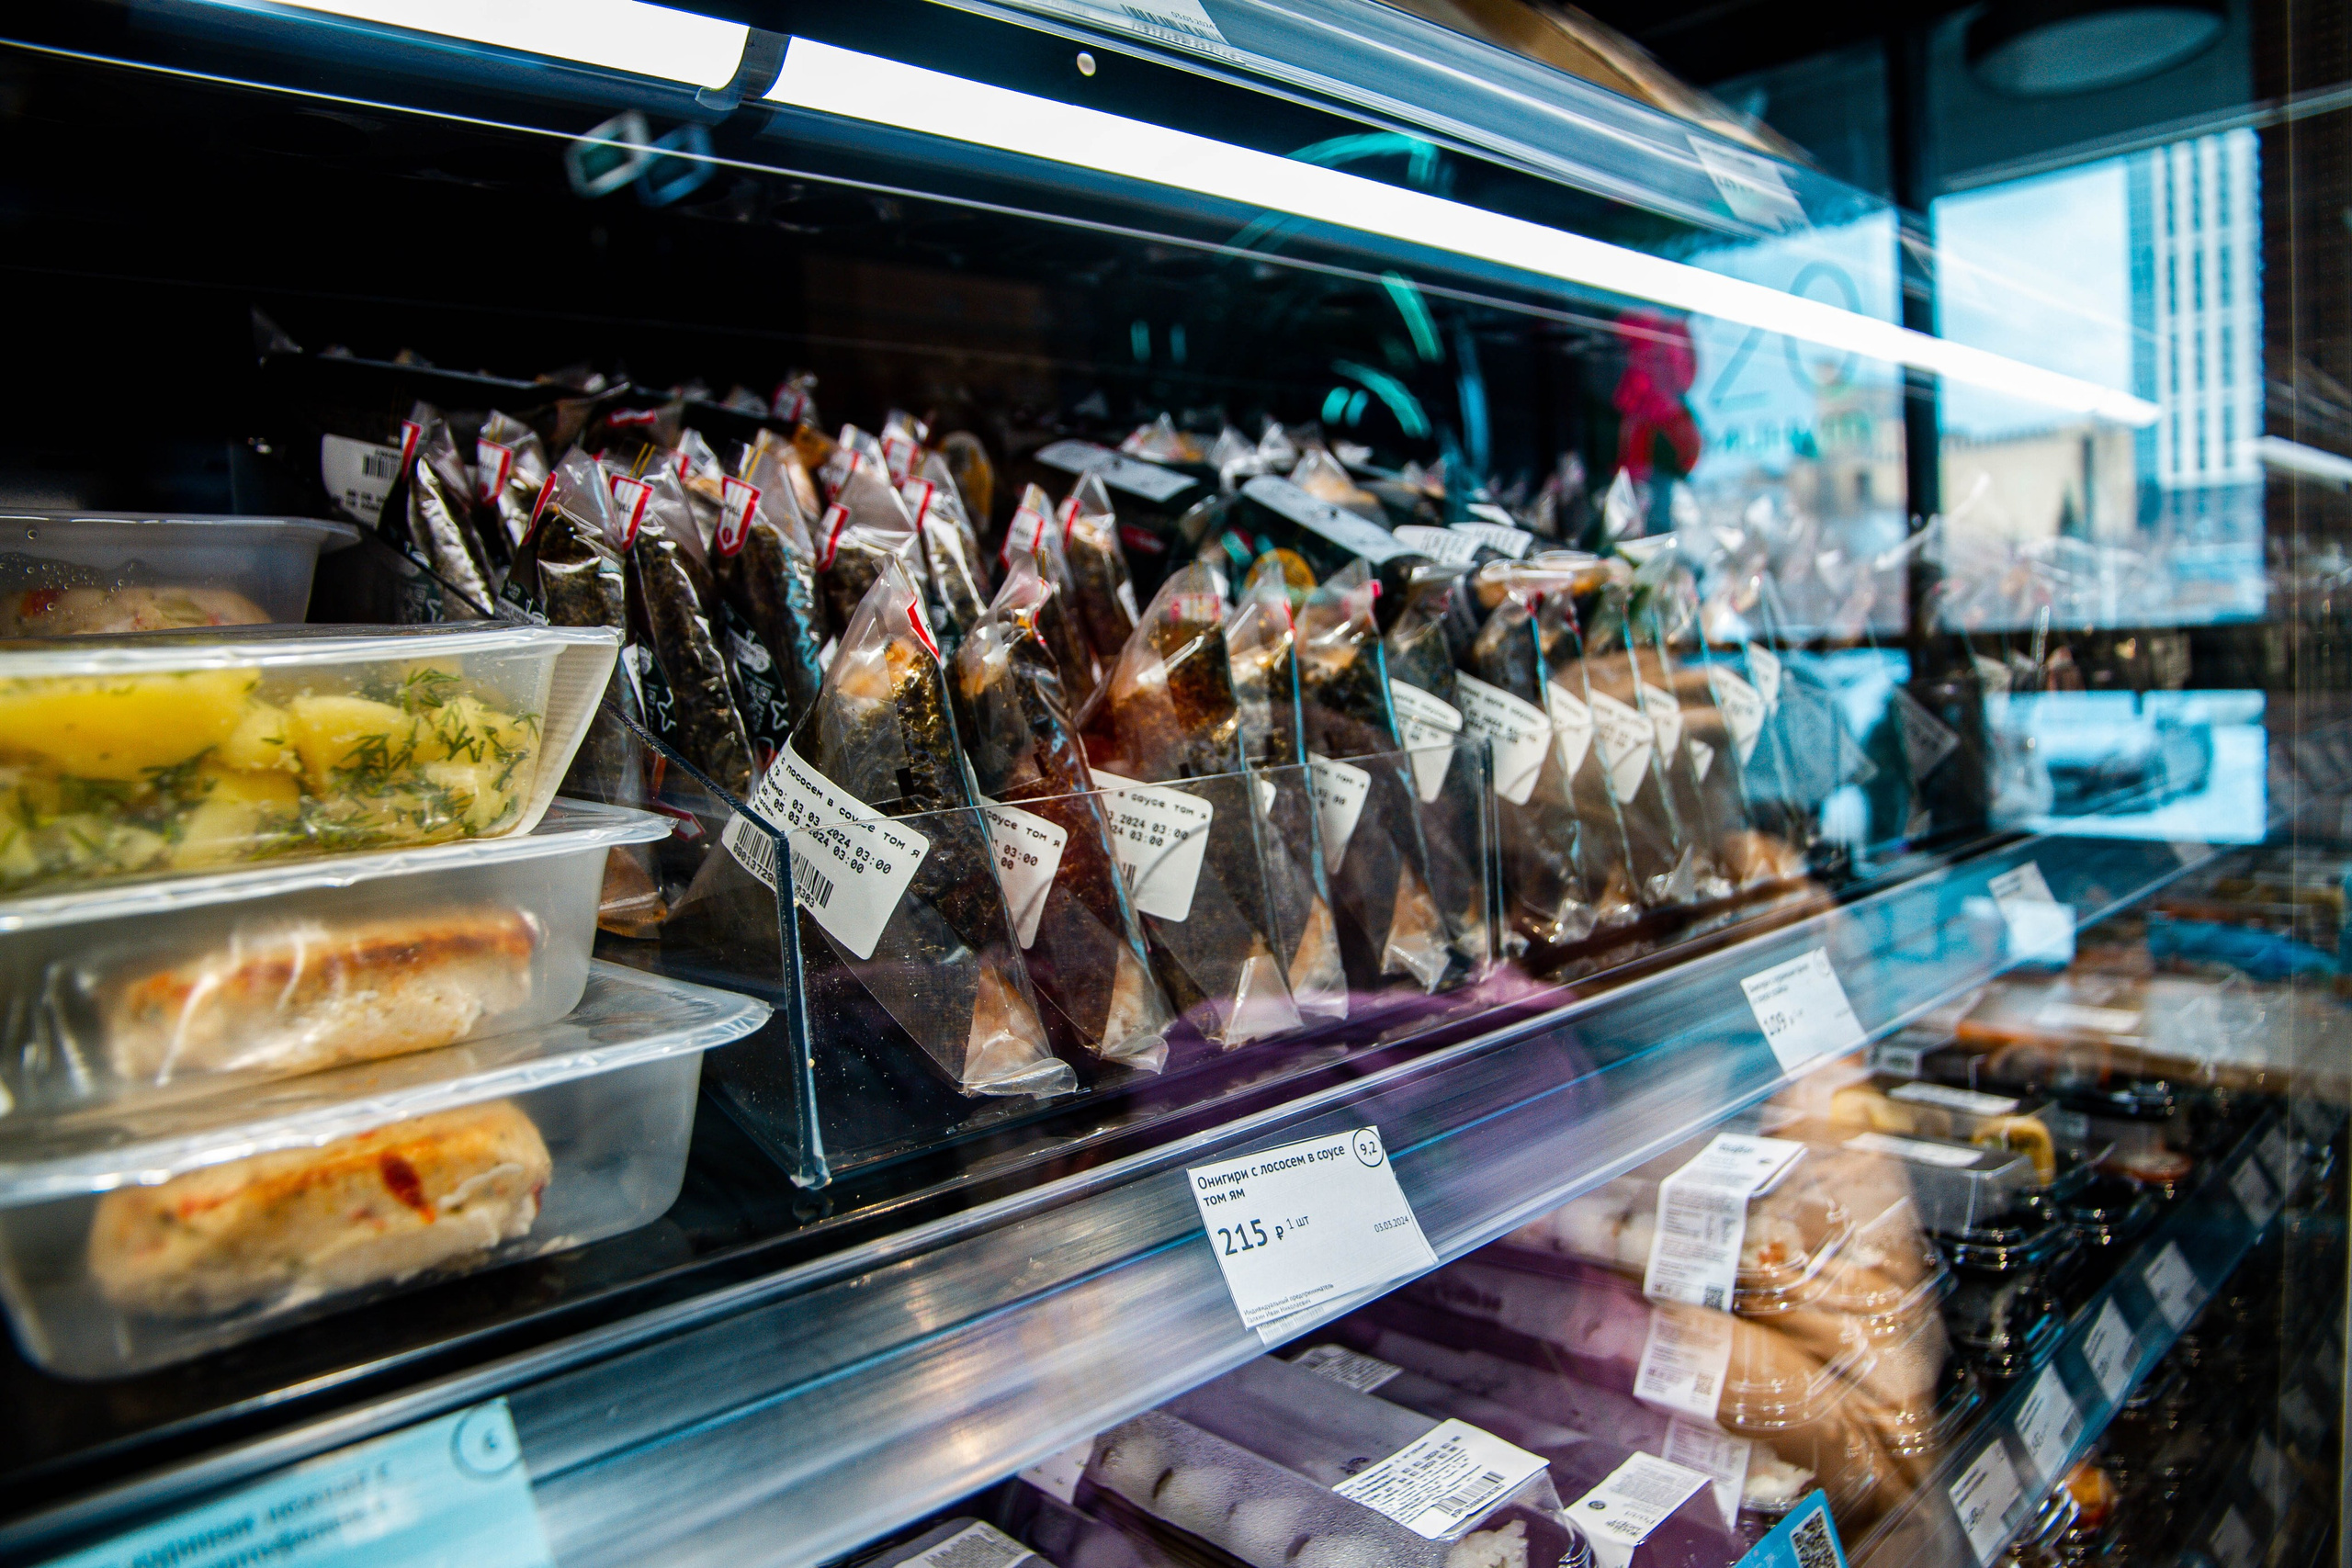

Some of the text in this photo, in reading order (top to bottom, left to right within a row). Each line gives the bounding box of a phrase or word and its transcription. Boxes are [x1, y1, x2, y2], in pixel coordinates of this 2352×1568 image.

[884, 831, 906, 850] том
[1026, 827, 1047, 841] том
[1152, 822, 1189, 840] 03:00
[832, 845, 865, 874] 03:00
[855, 846, 892, 874] 03:00
[1003, 844, 1038, 866] 03:00
[1360, 1141, 1377, 1156] 9,2
[1197, 1169, 1250, 1190] Онигири
[1261, 1155, 1306, 1176] лососем
[1308, 1153, 1316, 1164] в
[1317, 1145, 1346, 1161] соусе
[1203, 1188, 1246, 1207] том ям
[1374, 1215, 1409, 1234] 03.03.2024
[1217, 1218, 1269, 1257] 215
[1295, 1215, 1310, 1228] шт
